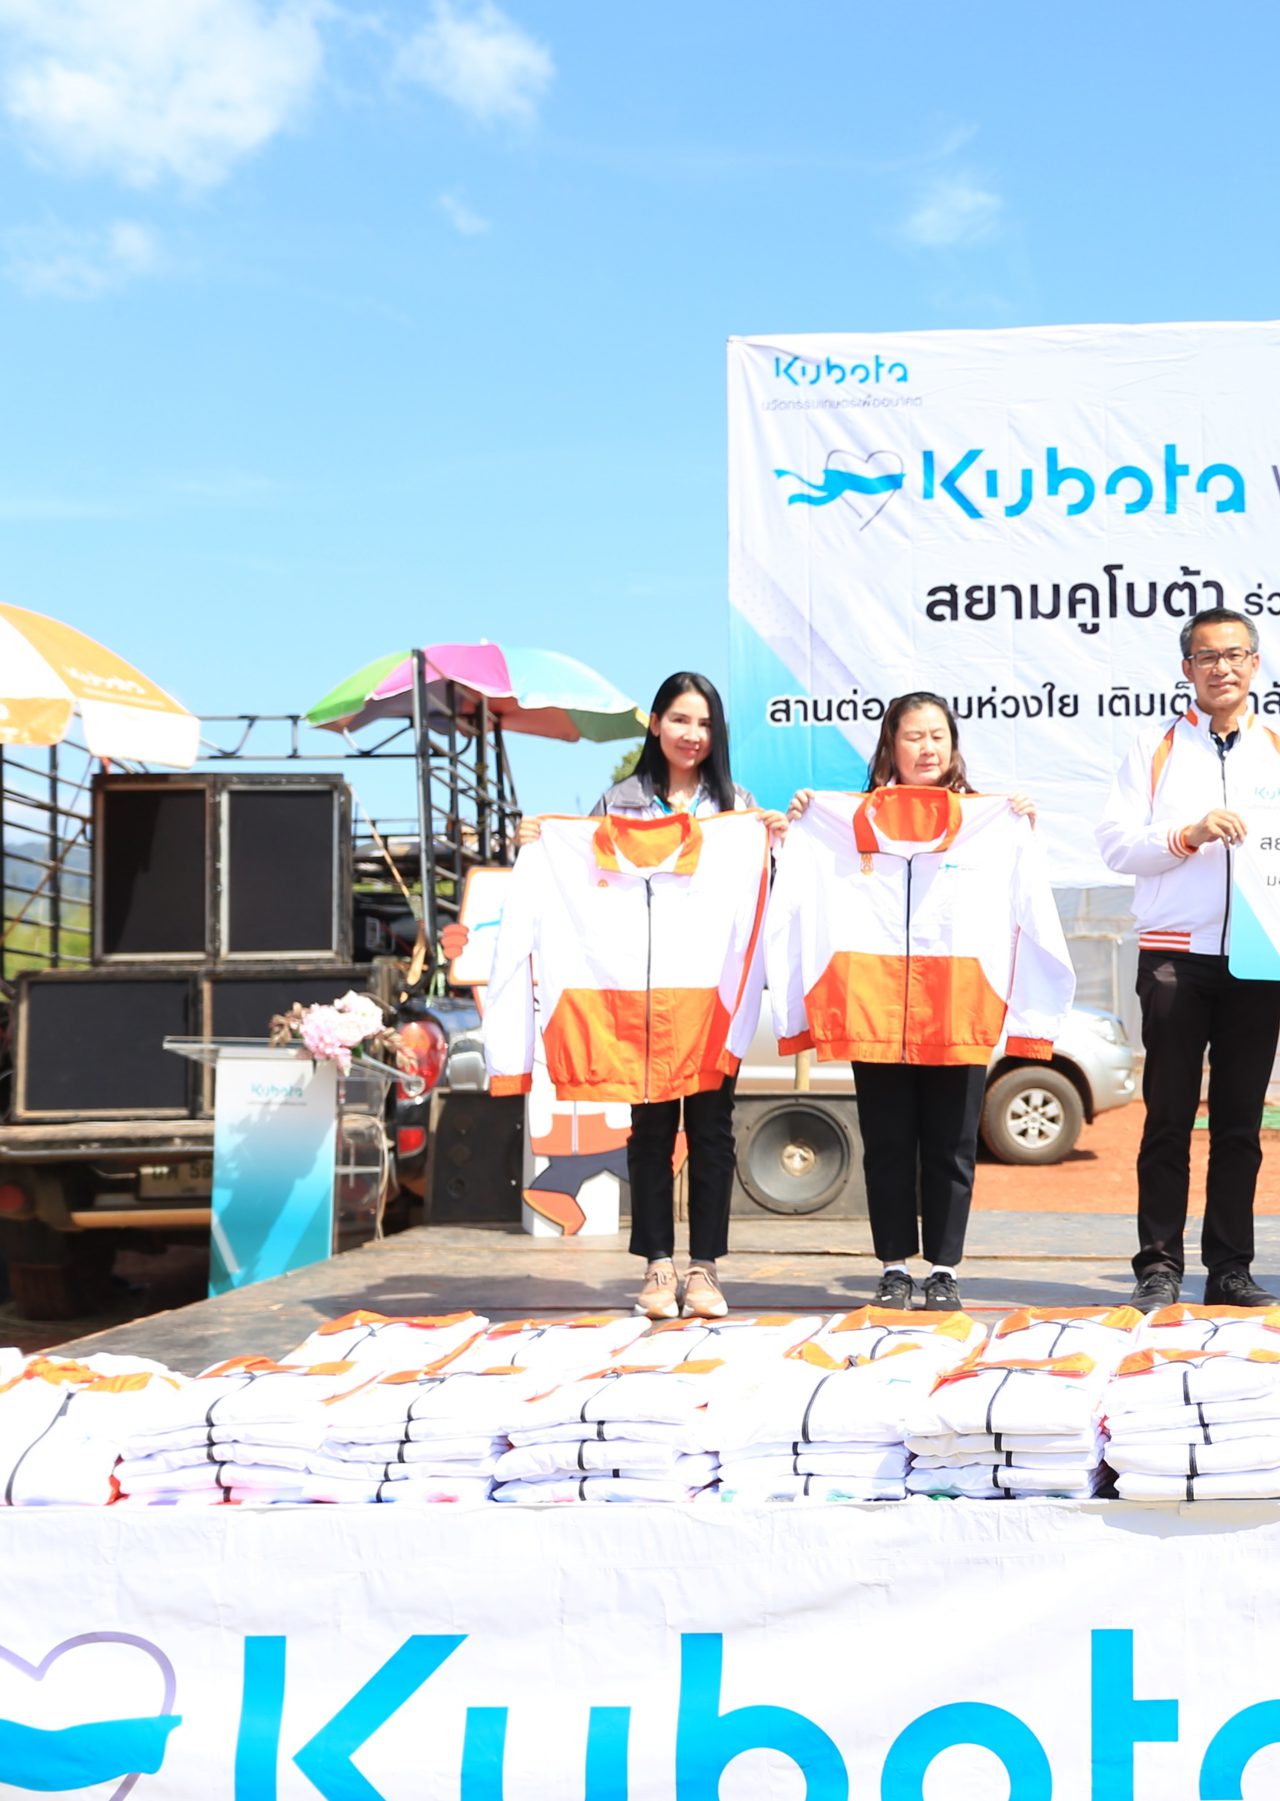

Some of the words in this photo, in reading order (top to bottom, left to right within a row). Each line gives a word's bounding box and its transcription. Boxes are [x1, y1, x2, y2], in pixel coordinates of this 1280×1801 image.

[774, 354, 909, 386] Kubota
[921, 443, 1247, 520] Kubota
[925, 563, 1225, 634] สยามคูโบต้า
